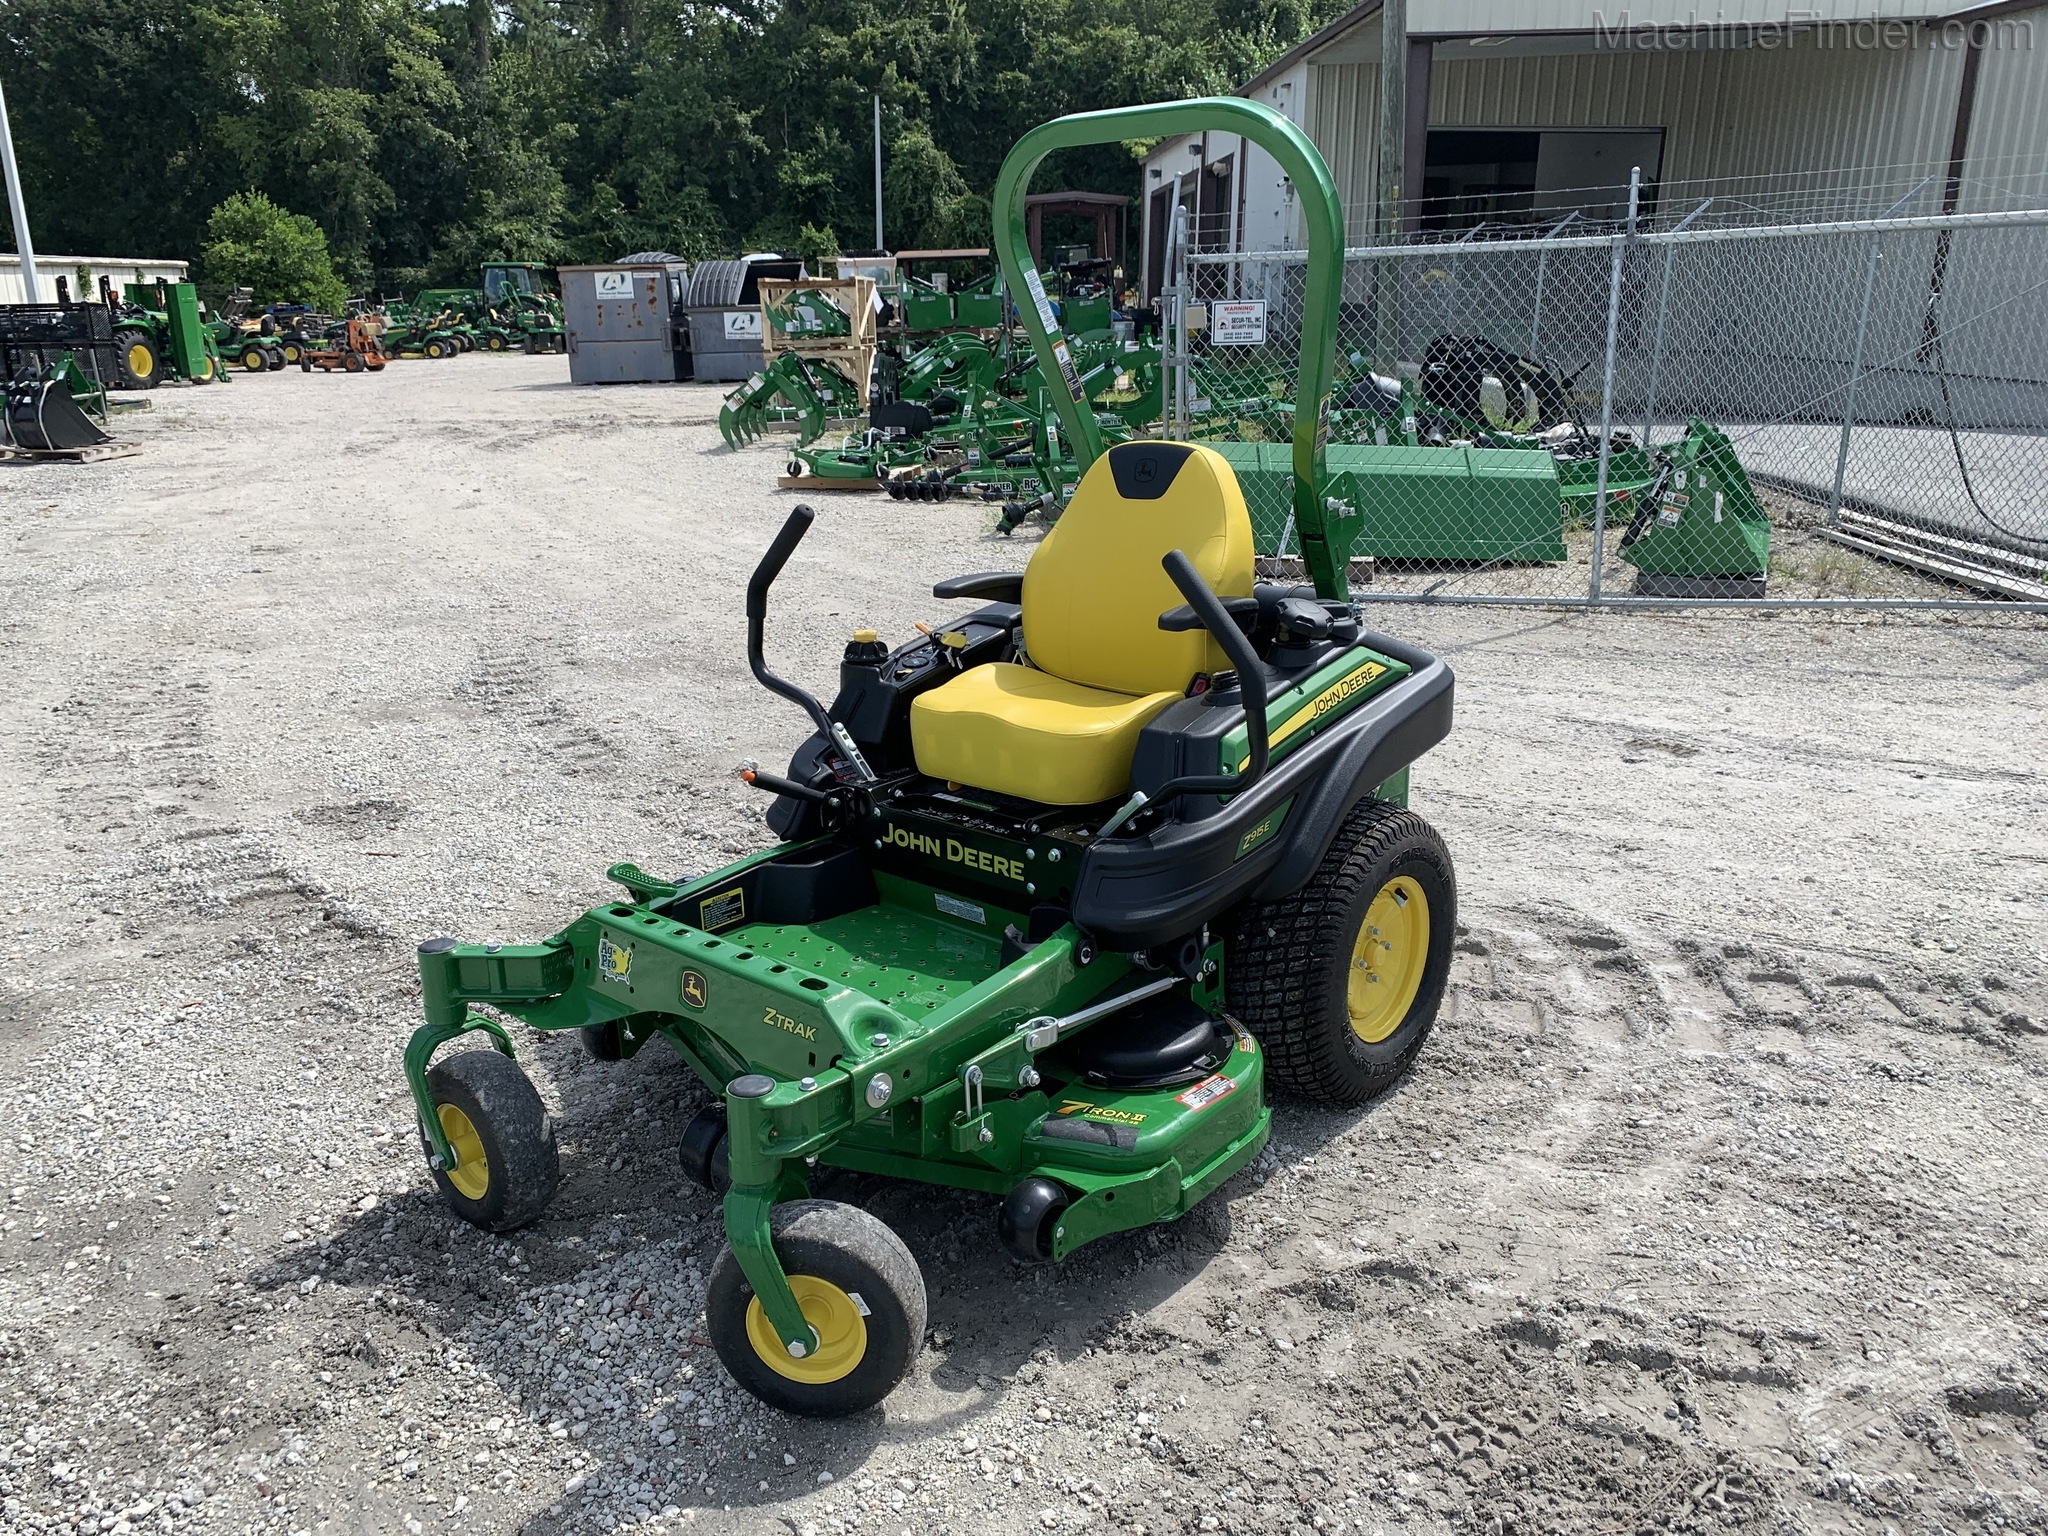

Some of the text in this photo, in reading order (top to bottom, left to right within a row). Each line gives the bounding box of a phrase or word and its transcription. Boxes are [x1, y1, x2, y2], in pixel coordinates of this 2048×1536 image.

[1312, 667, 1375, 718] JOHN DEERE
[882, 822, 1025, 881] JOHN DEERE
[763, 1006, 818, 1042] ZTRAK
[1084, 1113, 1128, 1123] Commercial
